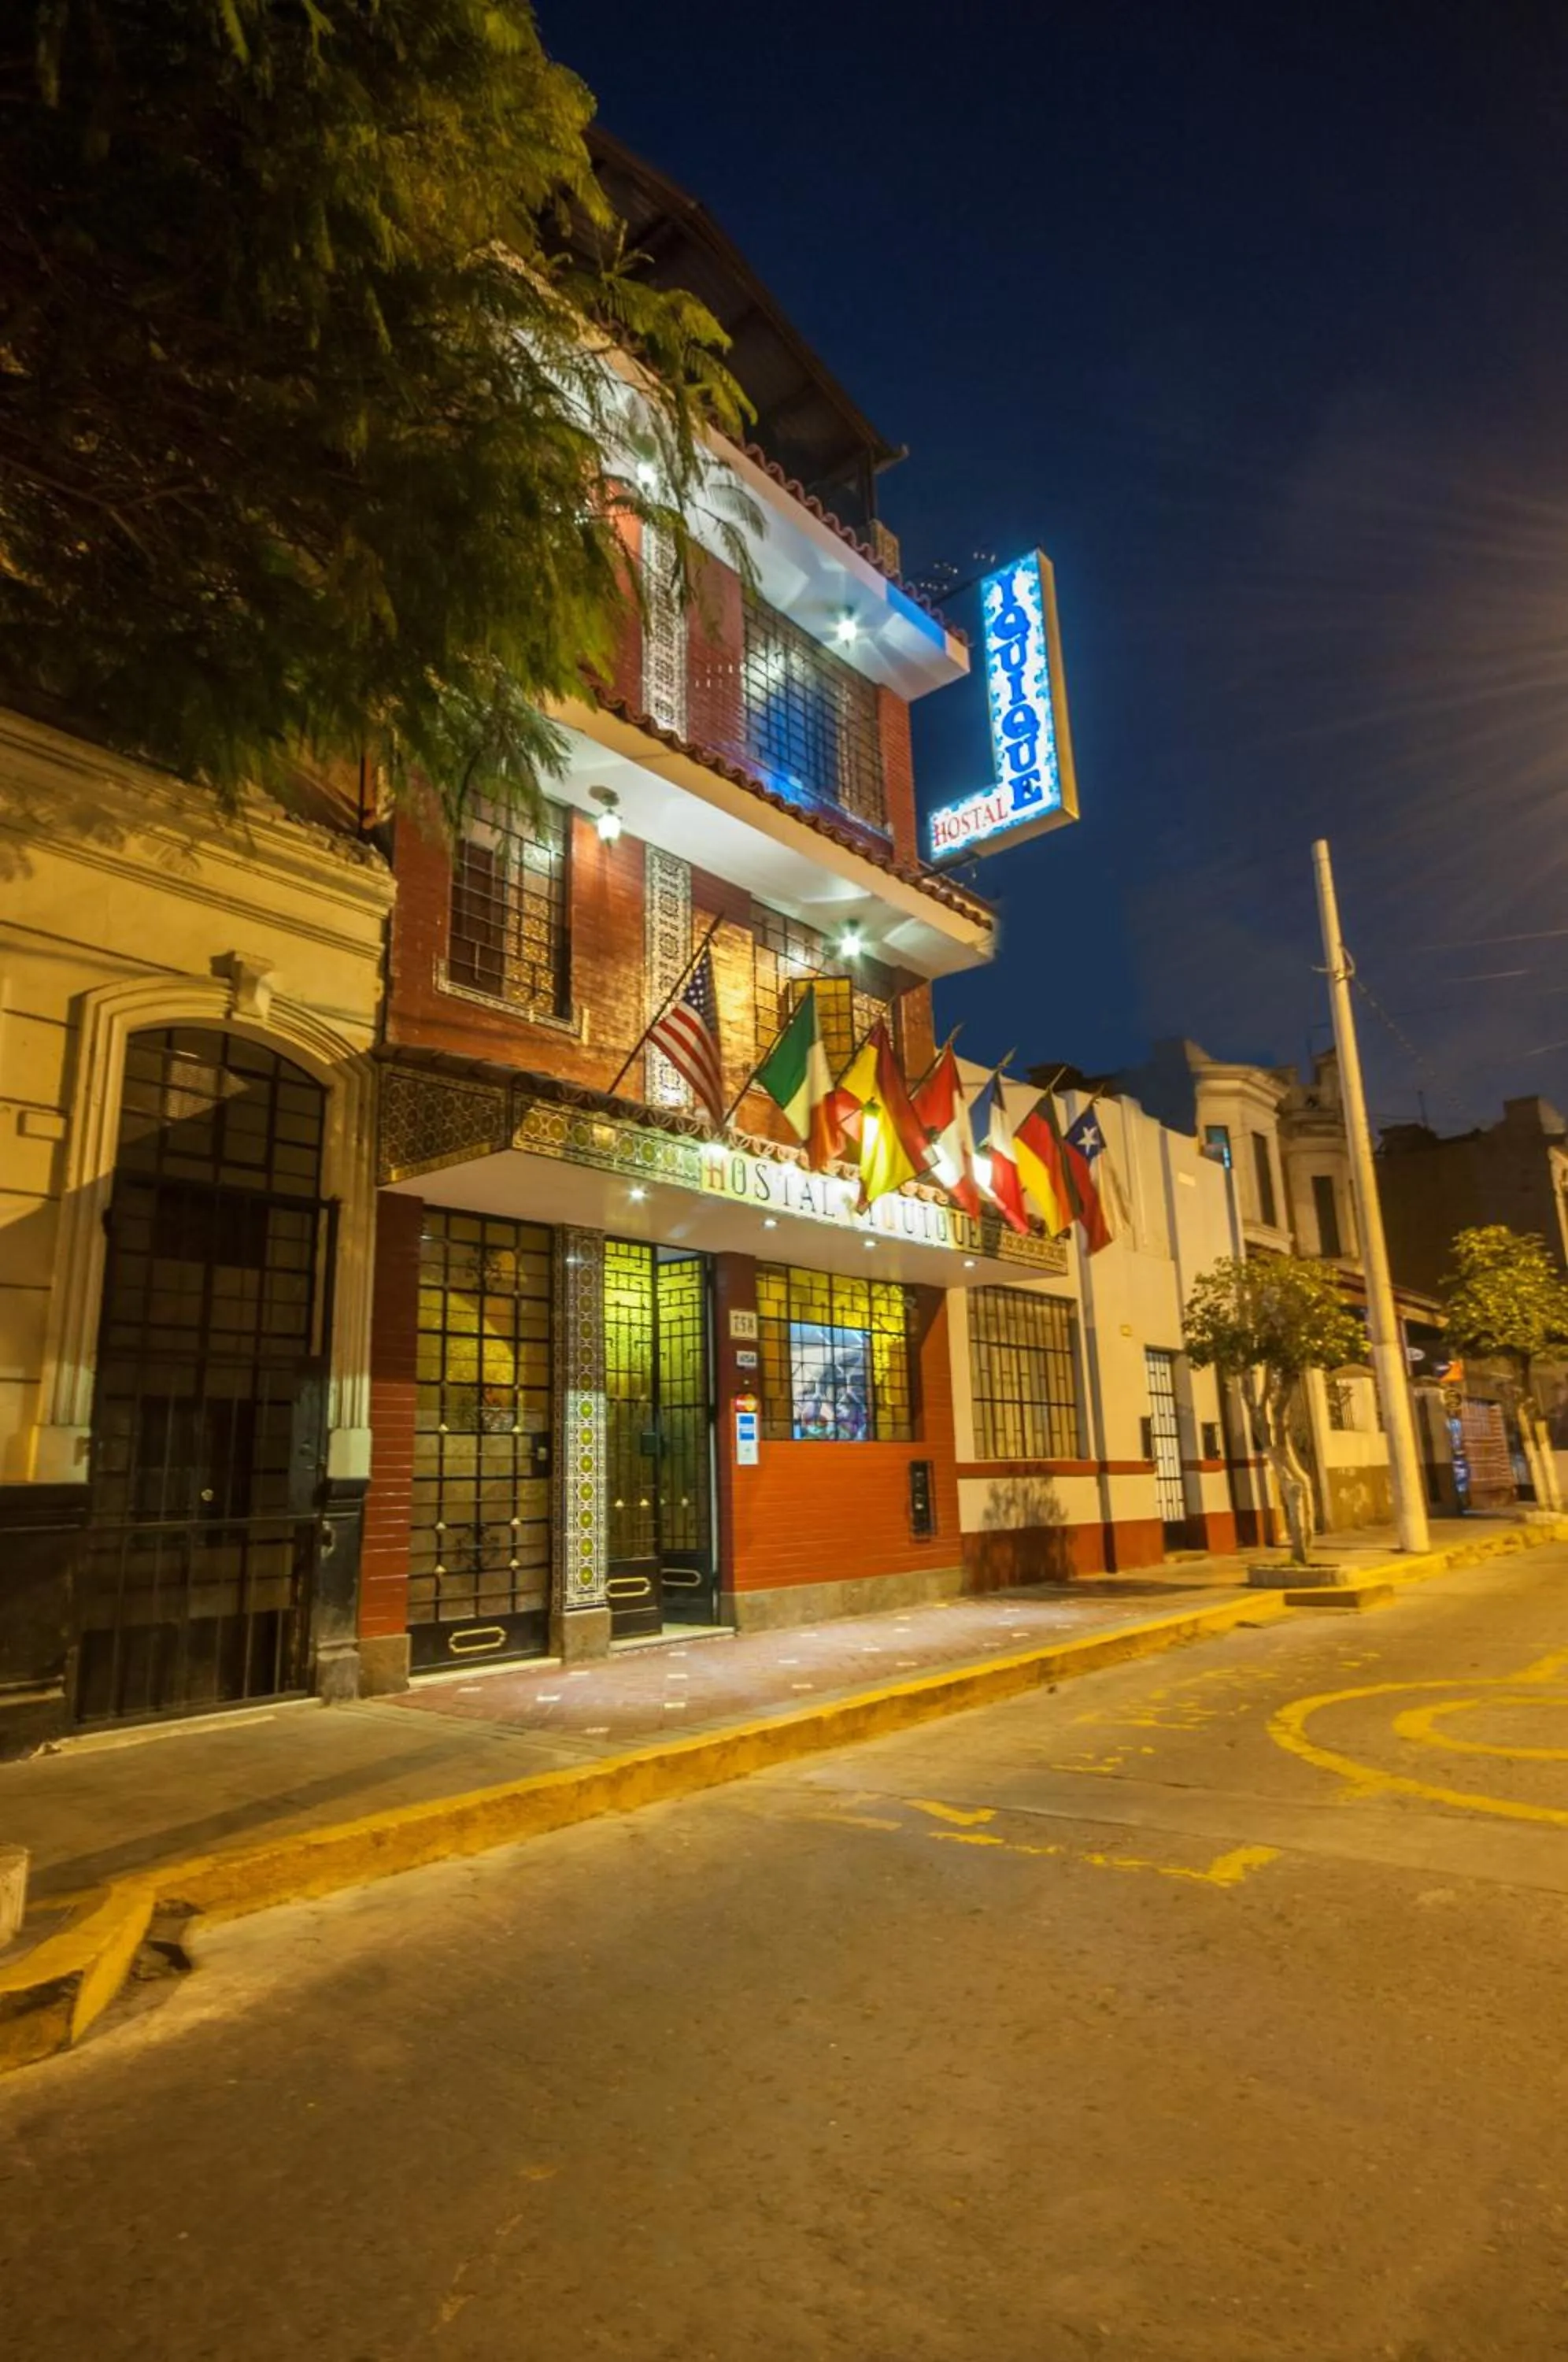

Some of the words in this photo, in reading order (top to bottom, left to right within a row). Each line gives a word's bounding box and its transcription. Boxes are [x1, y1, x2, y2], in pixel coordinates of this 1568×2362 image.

[992, 572, 1042, 811] IQUIQUE
[934, 798, 1008, 846] HOSTAL
[706, 1155, 835, 1217] HOSTAL
